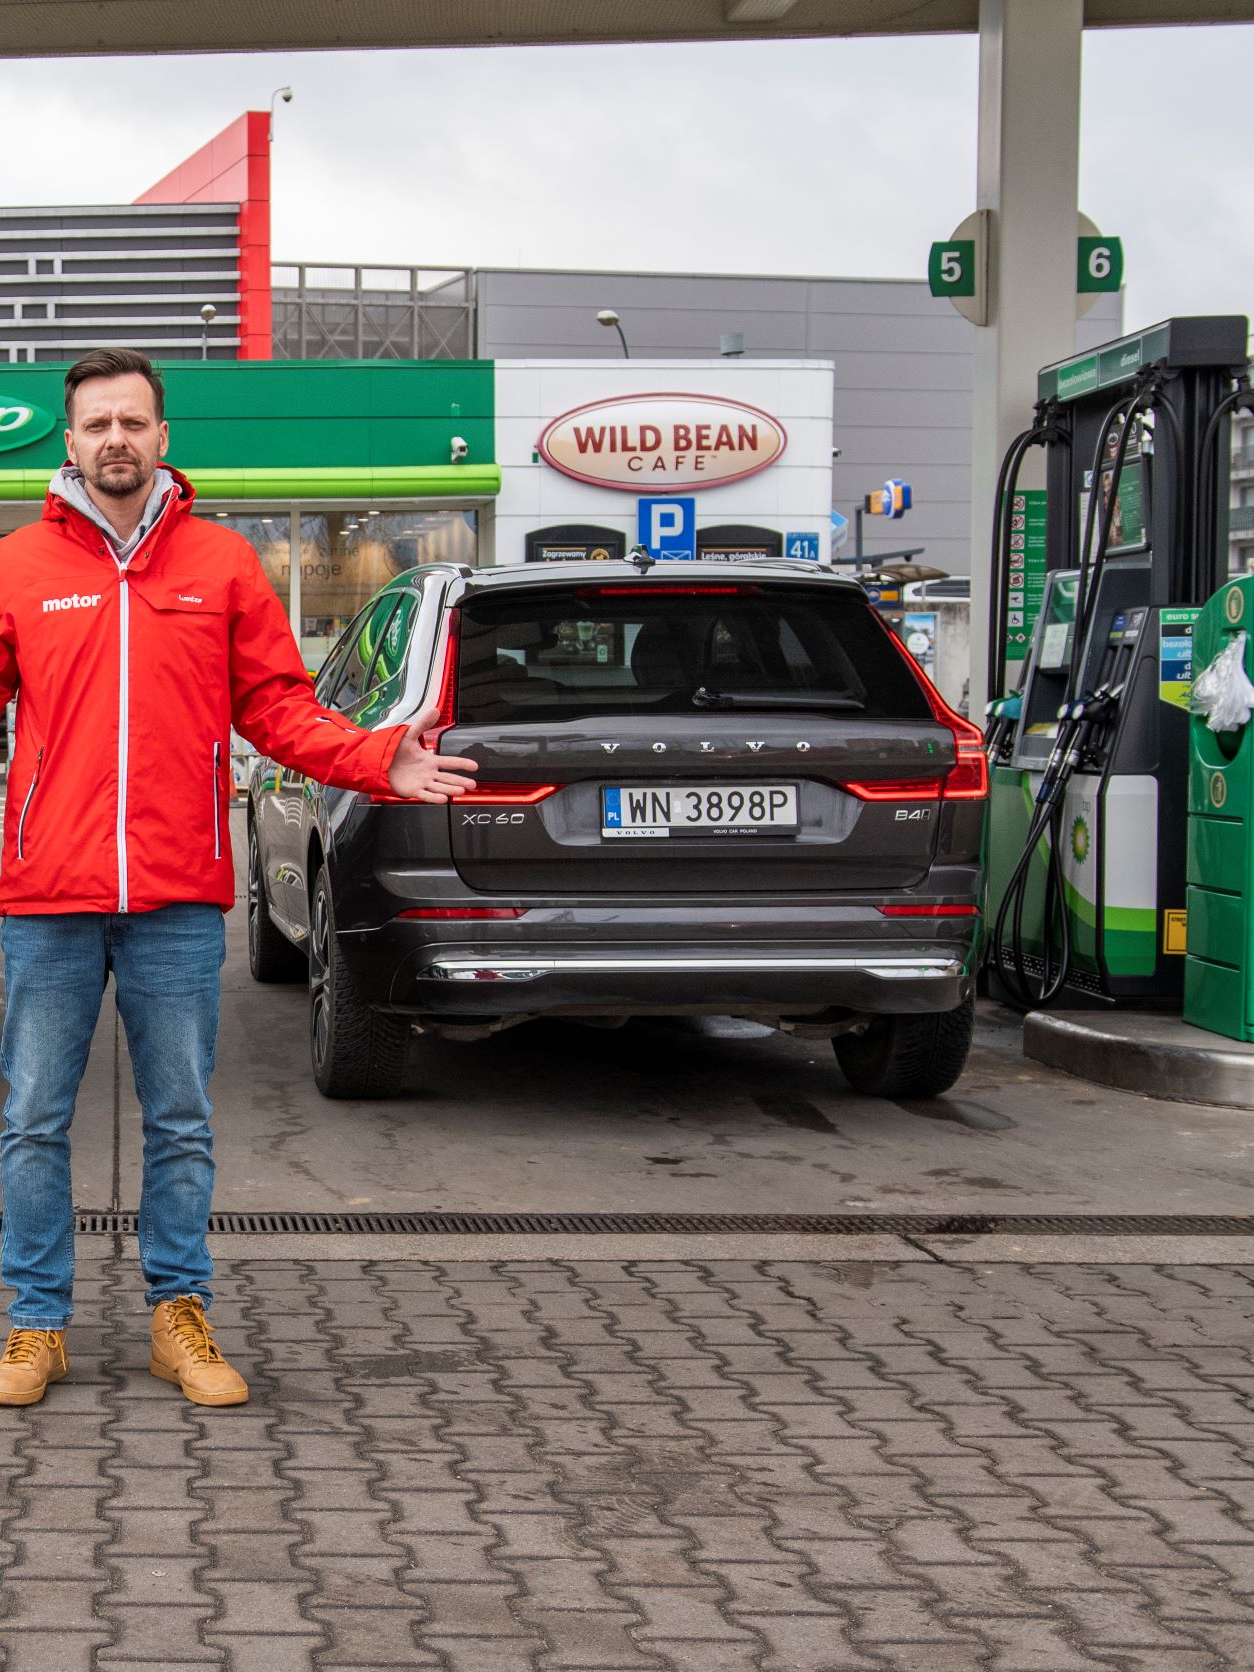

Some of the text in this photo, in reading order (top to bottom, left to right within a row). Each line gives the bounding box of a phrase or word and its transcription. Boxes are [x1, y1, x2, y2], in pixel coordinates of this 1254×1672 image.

[940, 251, 962, 283] 5
[1088, 246, 1111, 279] 6
[1120, 348, 1140, 367] diesel
[572, 423, 759, 454] WILD BEAN
[627, 455, 706, 472] CAFE
[651, 503, 684, 550] P
[281, 563, 343, 580] npoje
[42, 594, 102, 612] motor
[1166, 613, 1189, 621] euro
[601, 742, 811, 754] VOLVO
[628, 790, 789, 823] WN 3898P
[607, 812, 620, 821] PL
